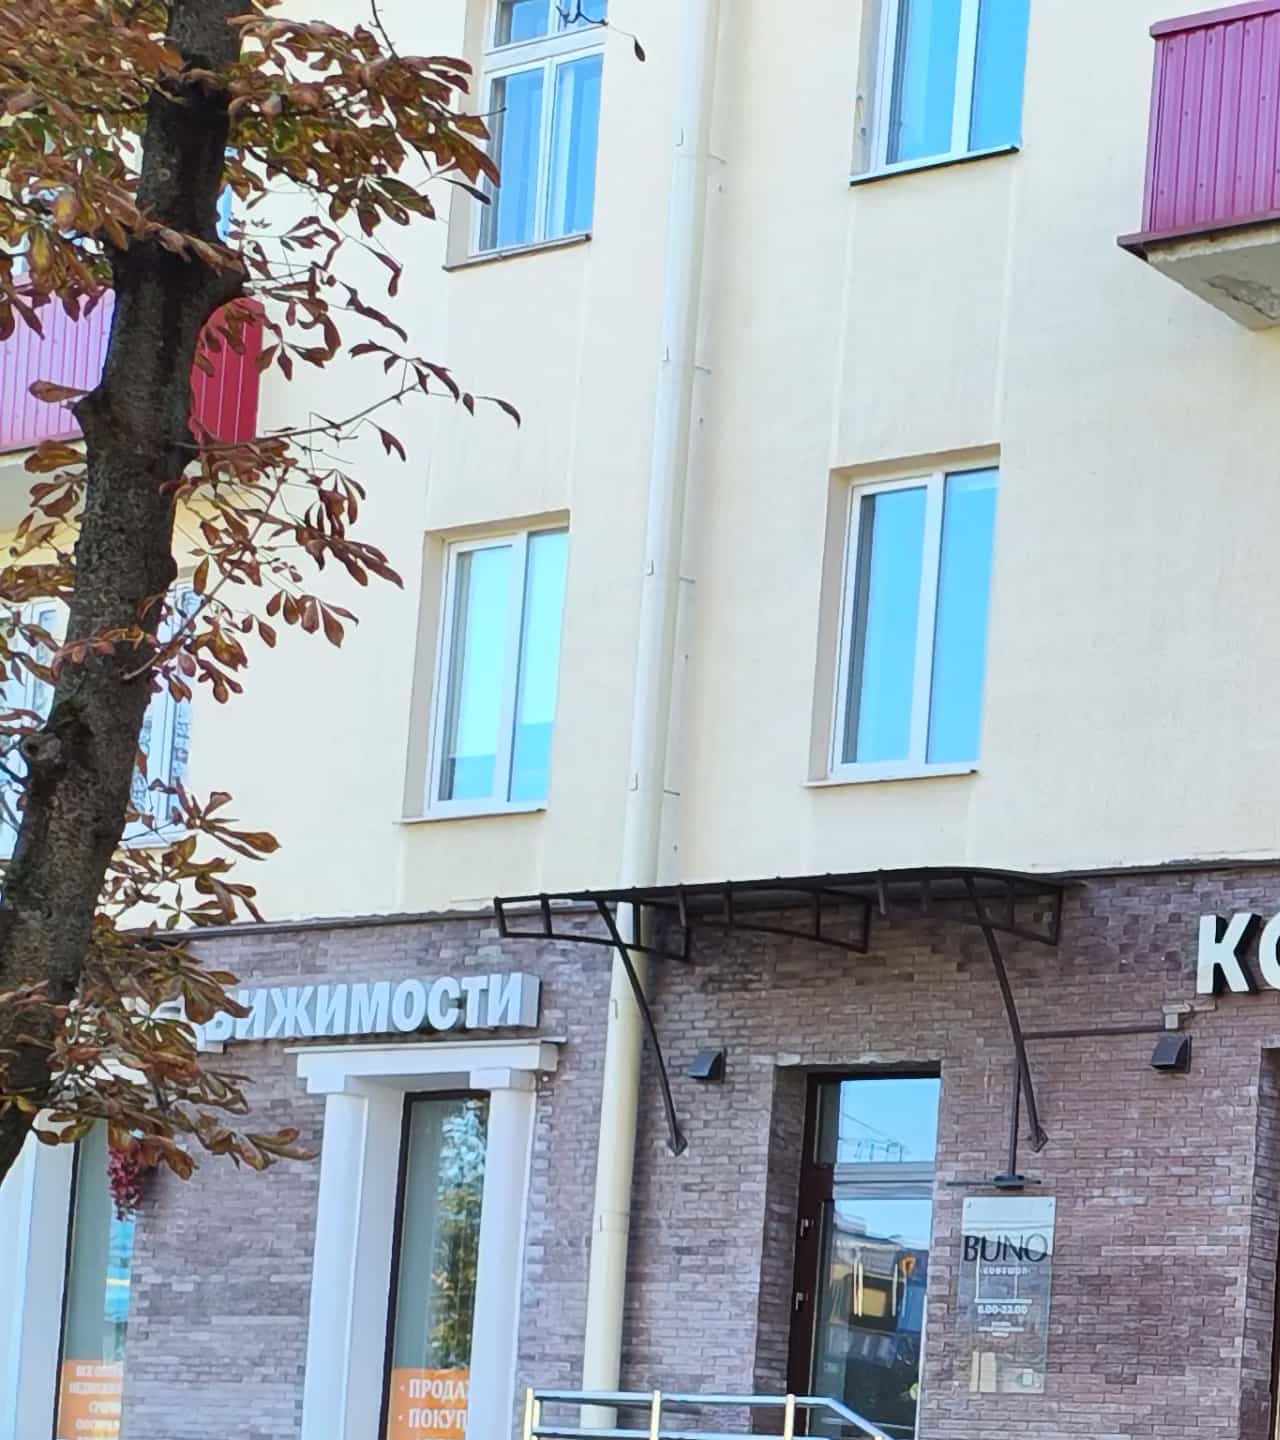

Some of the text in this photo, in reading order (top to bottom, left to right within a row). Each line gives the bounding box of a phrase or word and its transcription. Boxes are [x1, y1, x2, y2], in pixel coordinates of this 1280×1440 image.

[963, 1233, 1049, 1263] BUNO
[408, 1378, 469, 1403] ПРОДА
[408, 1408, 468, 1429] ПОКУП
